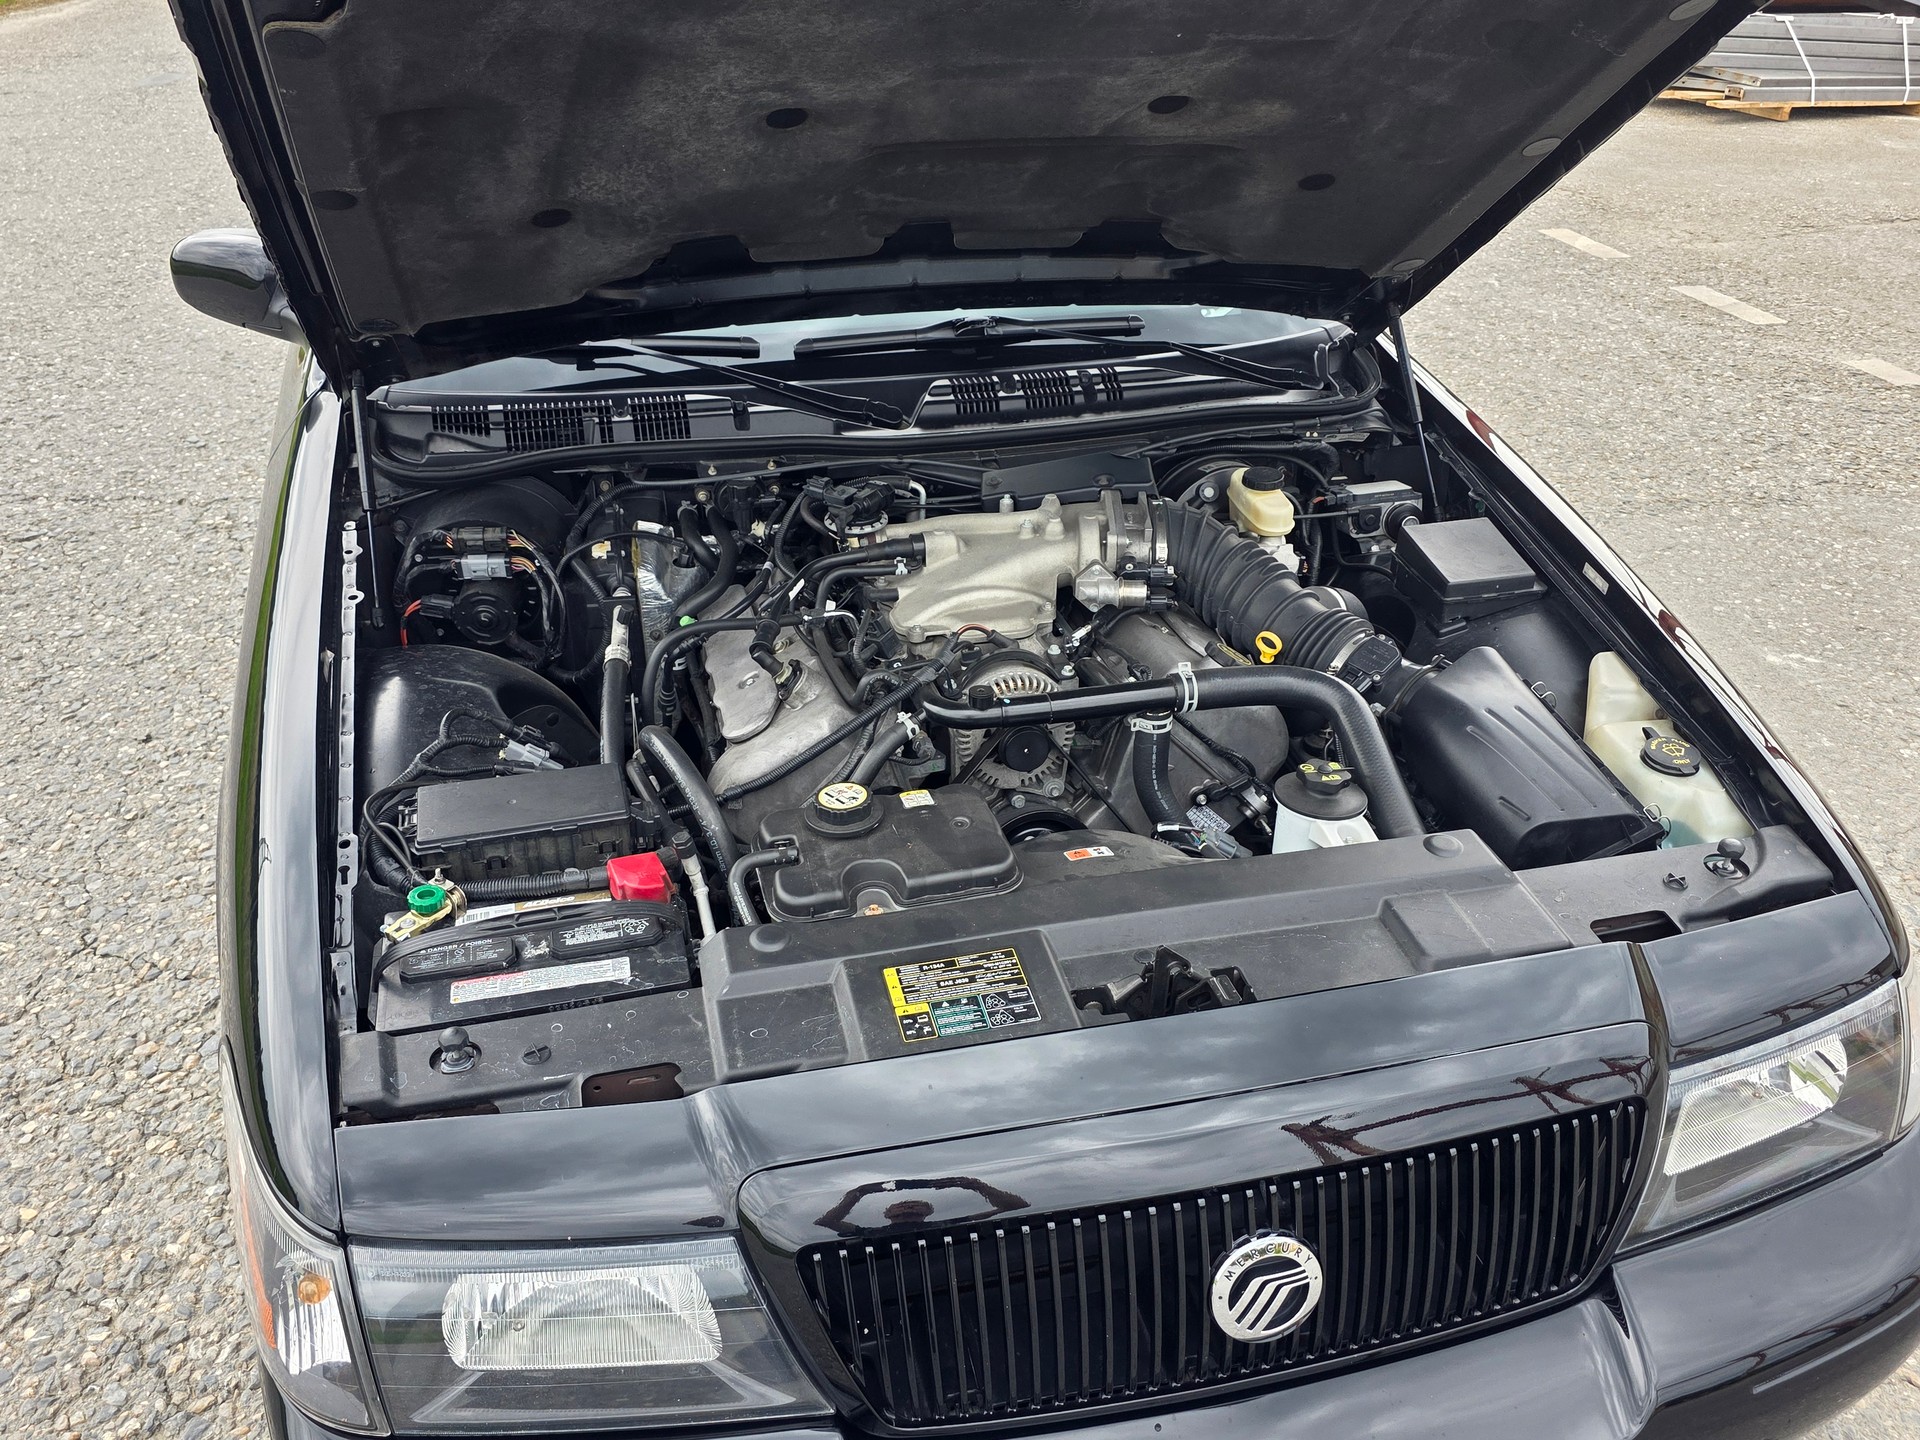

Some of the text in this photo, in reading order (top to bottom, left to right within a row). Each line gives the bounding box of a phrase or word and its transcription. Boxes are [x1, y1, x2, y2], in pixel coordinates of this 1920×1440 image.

[1650, 737, 1691, 750] WASHER FLUID
[522, 896, 575, 908] ACDelco
[427, 944, 457, 953] DANGER
[465, 939, 493, 947] POISON
[922, 962, 945, 971] R-134A
[1224, 1242, 1312, 1281] MERCURY
